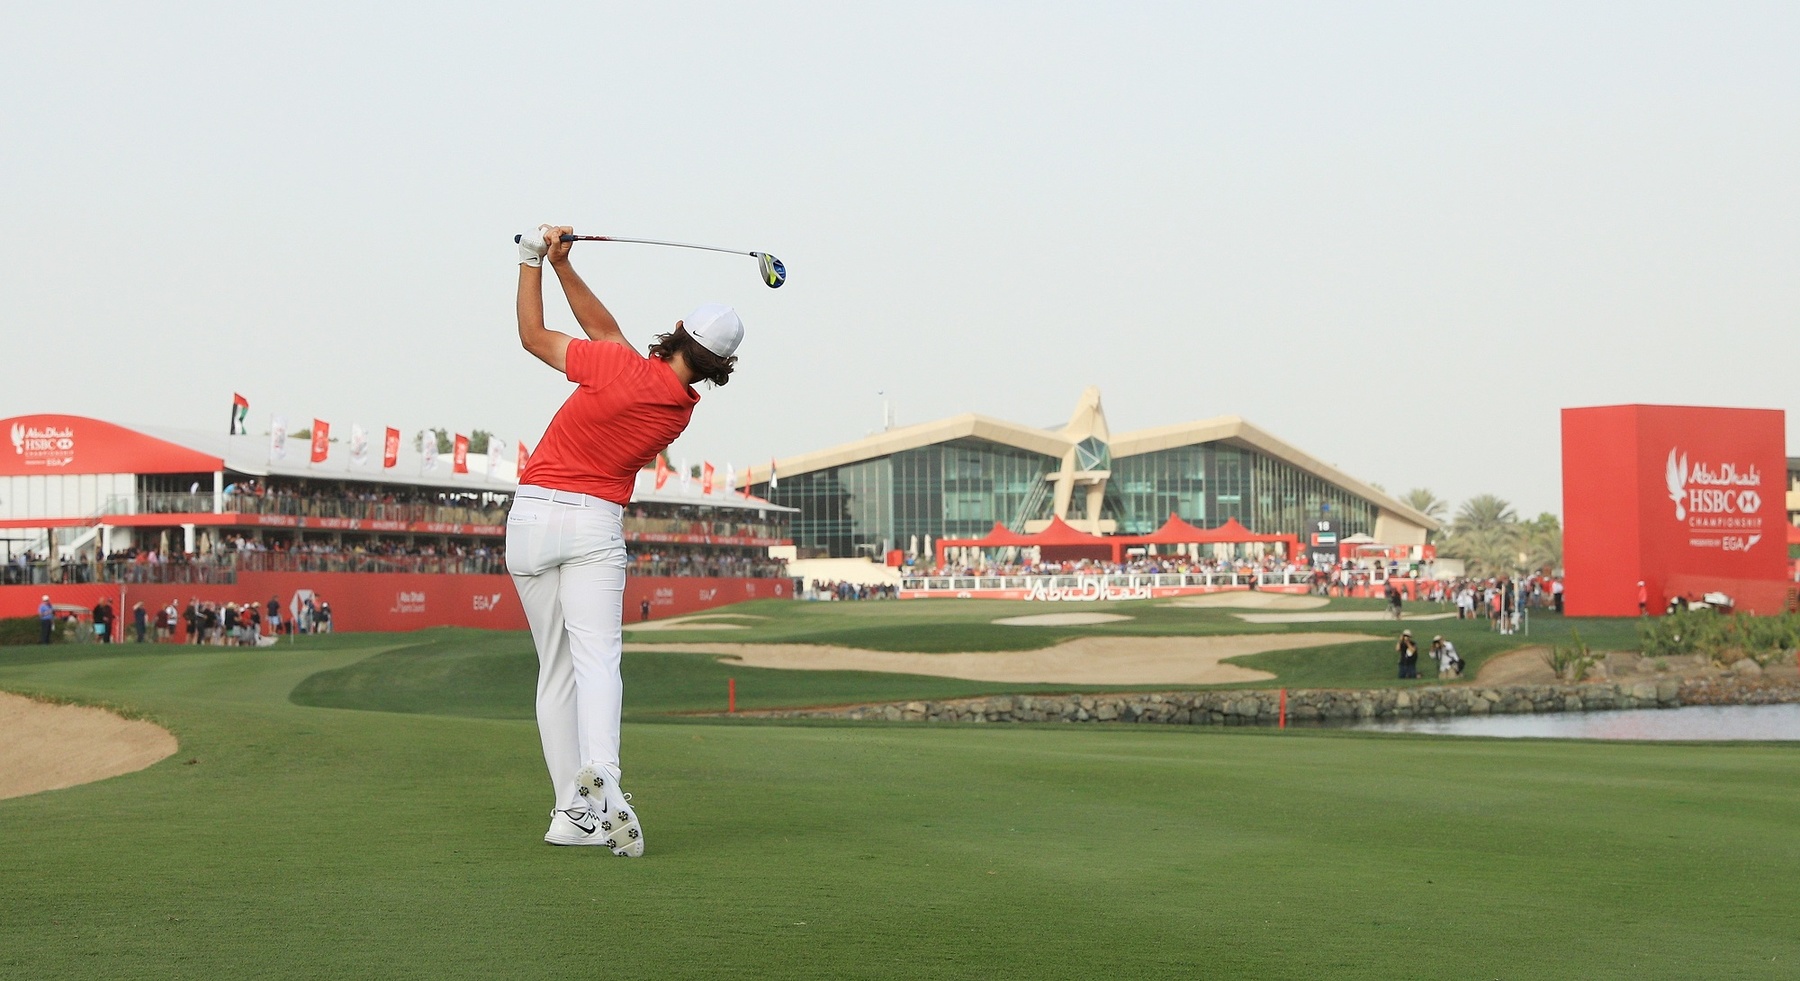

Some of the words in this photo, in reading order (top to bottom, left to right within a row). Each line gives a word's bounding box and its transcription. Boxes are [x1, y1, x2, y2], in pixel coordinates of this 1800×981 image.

[25, 439, 57, 450] HSBC
[1689, 489, 1736, 513] HSBC
[1317, 521, 1330, 531] 18
[1688, 517, 1762, 527] CHAMPIONSHIP
[1722, 536, 1744, 551] EGA
